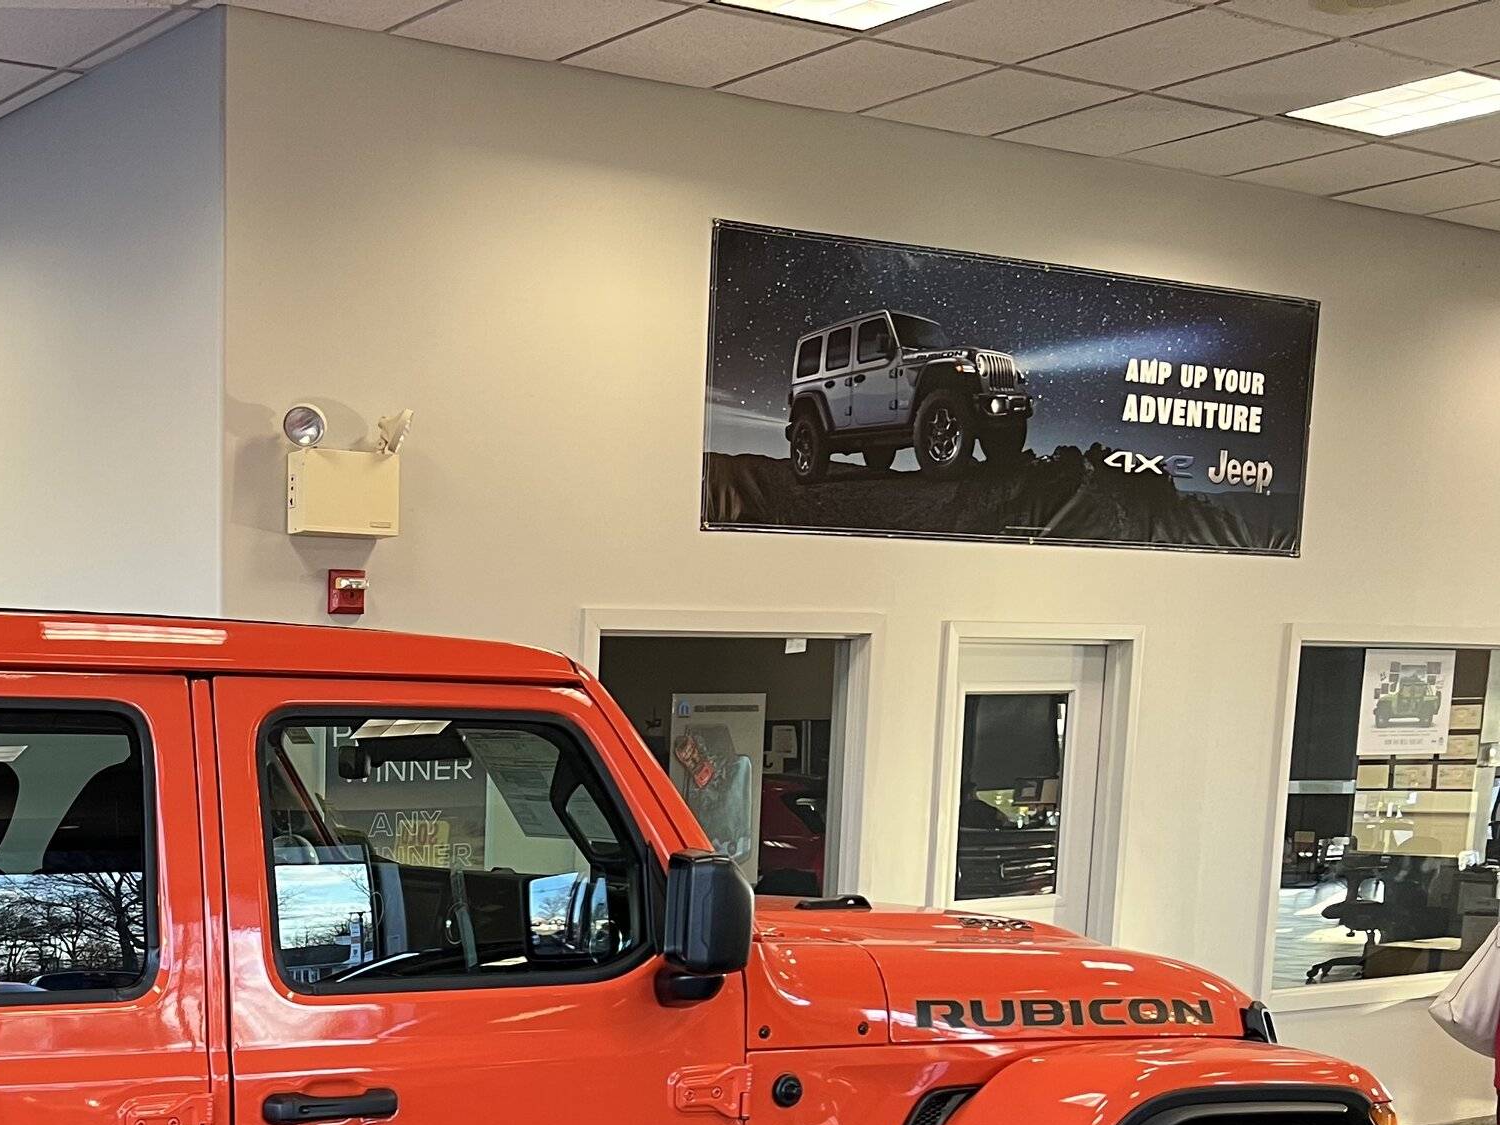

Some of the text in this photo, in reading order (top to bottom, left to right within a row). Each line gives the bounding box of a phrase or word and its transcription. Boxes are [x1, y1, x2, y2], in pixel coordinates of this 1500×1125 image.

[1125, 358, 1265, 396] AMP UP YOUR
[1122, 393, 1263, 434] ADVENTURE
[1208, 449, 1273, 494] Jeep
[346, 759, 473, 783] INNER
[367, 810, 442, 838] ANY
[915, 998, 1214, 1029] RUBICON
